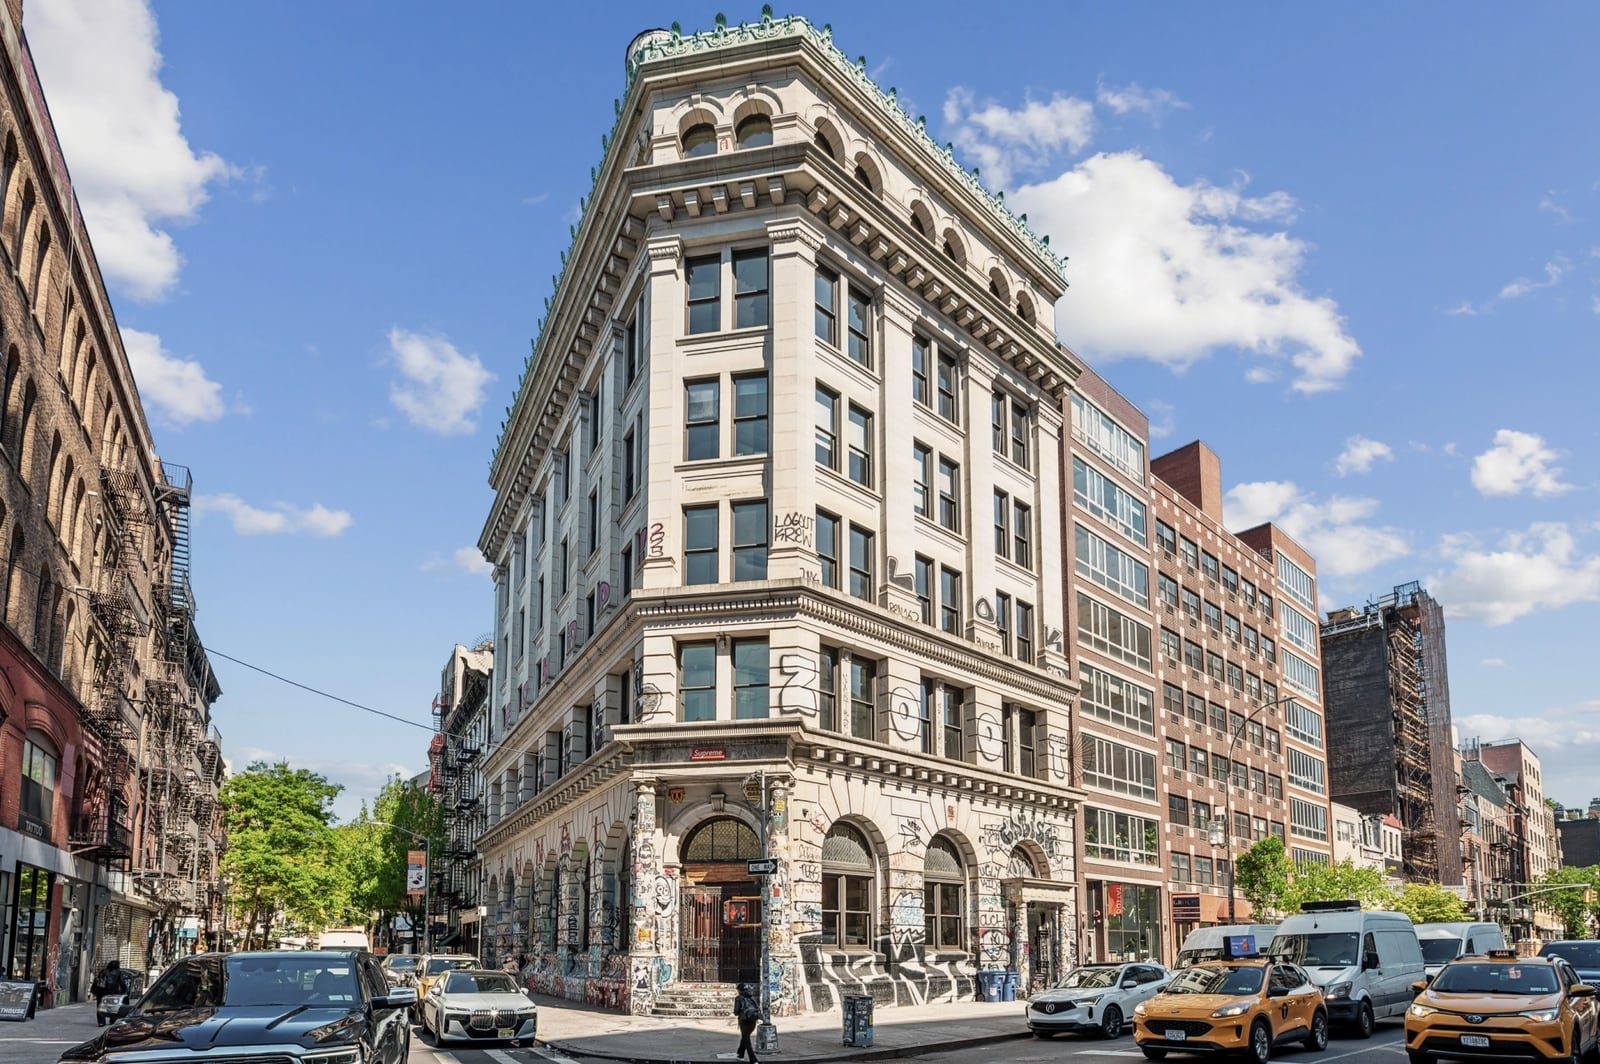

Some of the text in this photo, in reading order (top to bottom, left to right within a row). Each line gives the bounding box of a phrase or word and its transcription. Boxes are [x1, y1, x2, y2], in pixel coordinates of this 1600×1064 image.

[775, 527, 812, 548] KREW
[694, 749, 723, 758] Supreme
[26, 820, 43, 836] TATTOO
